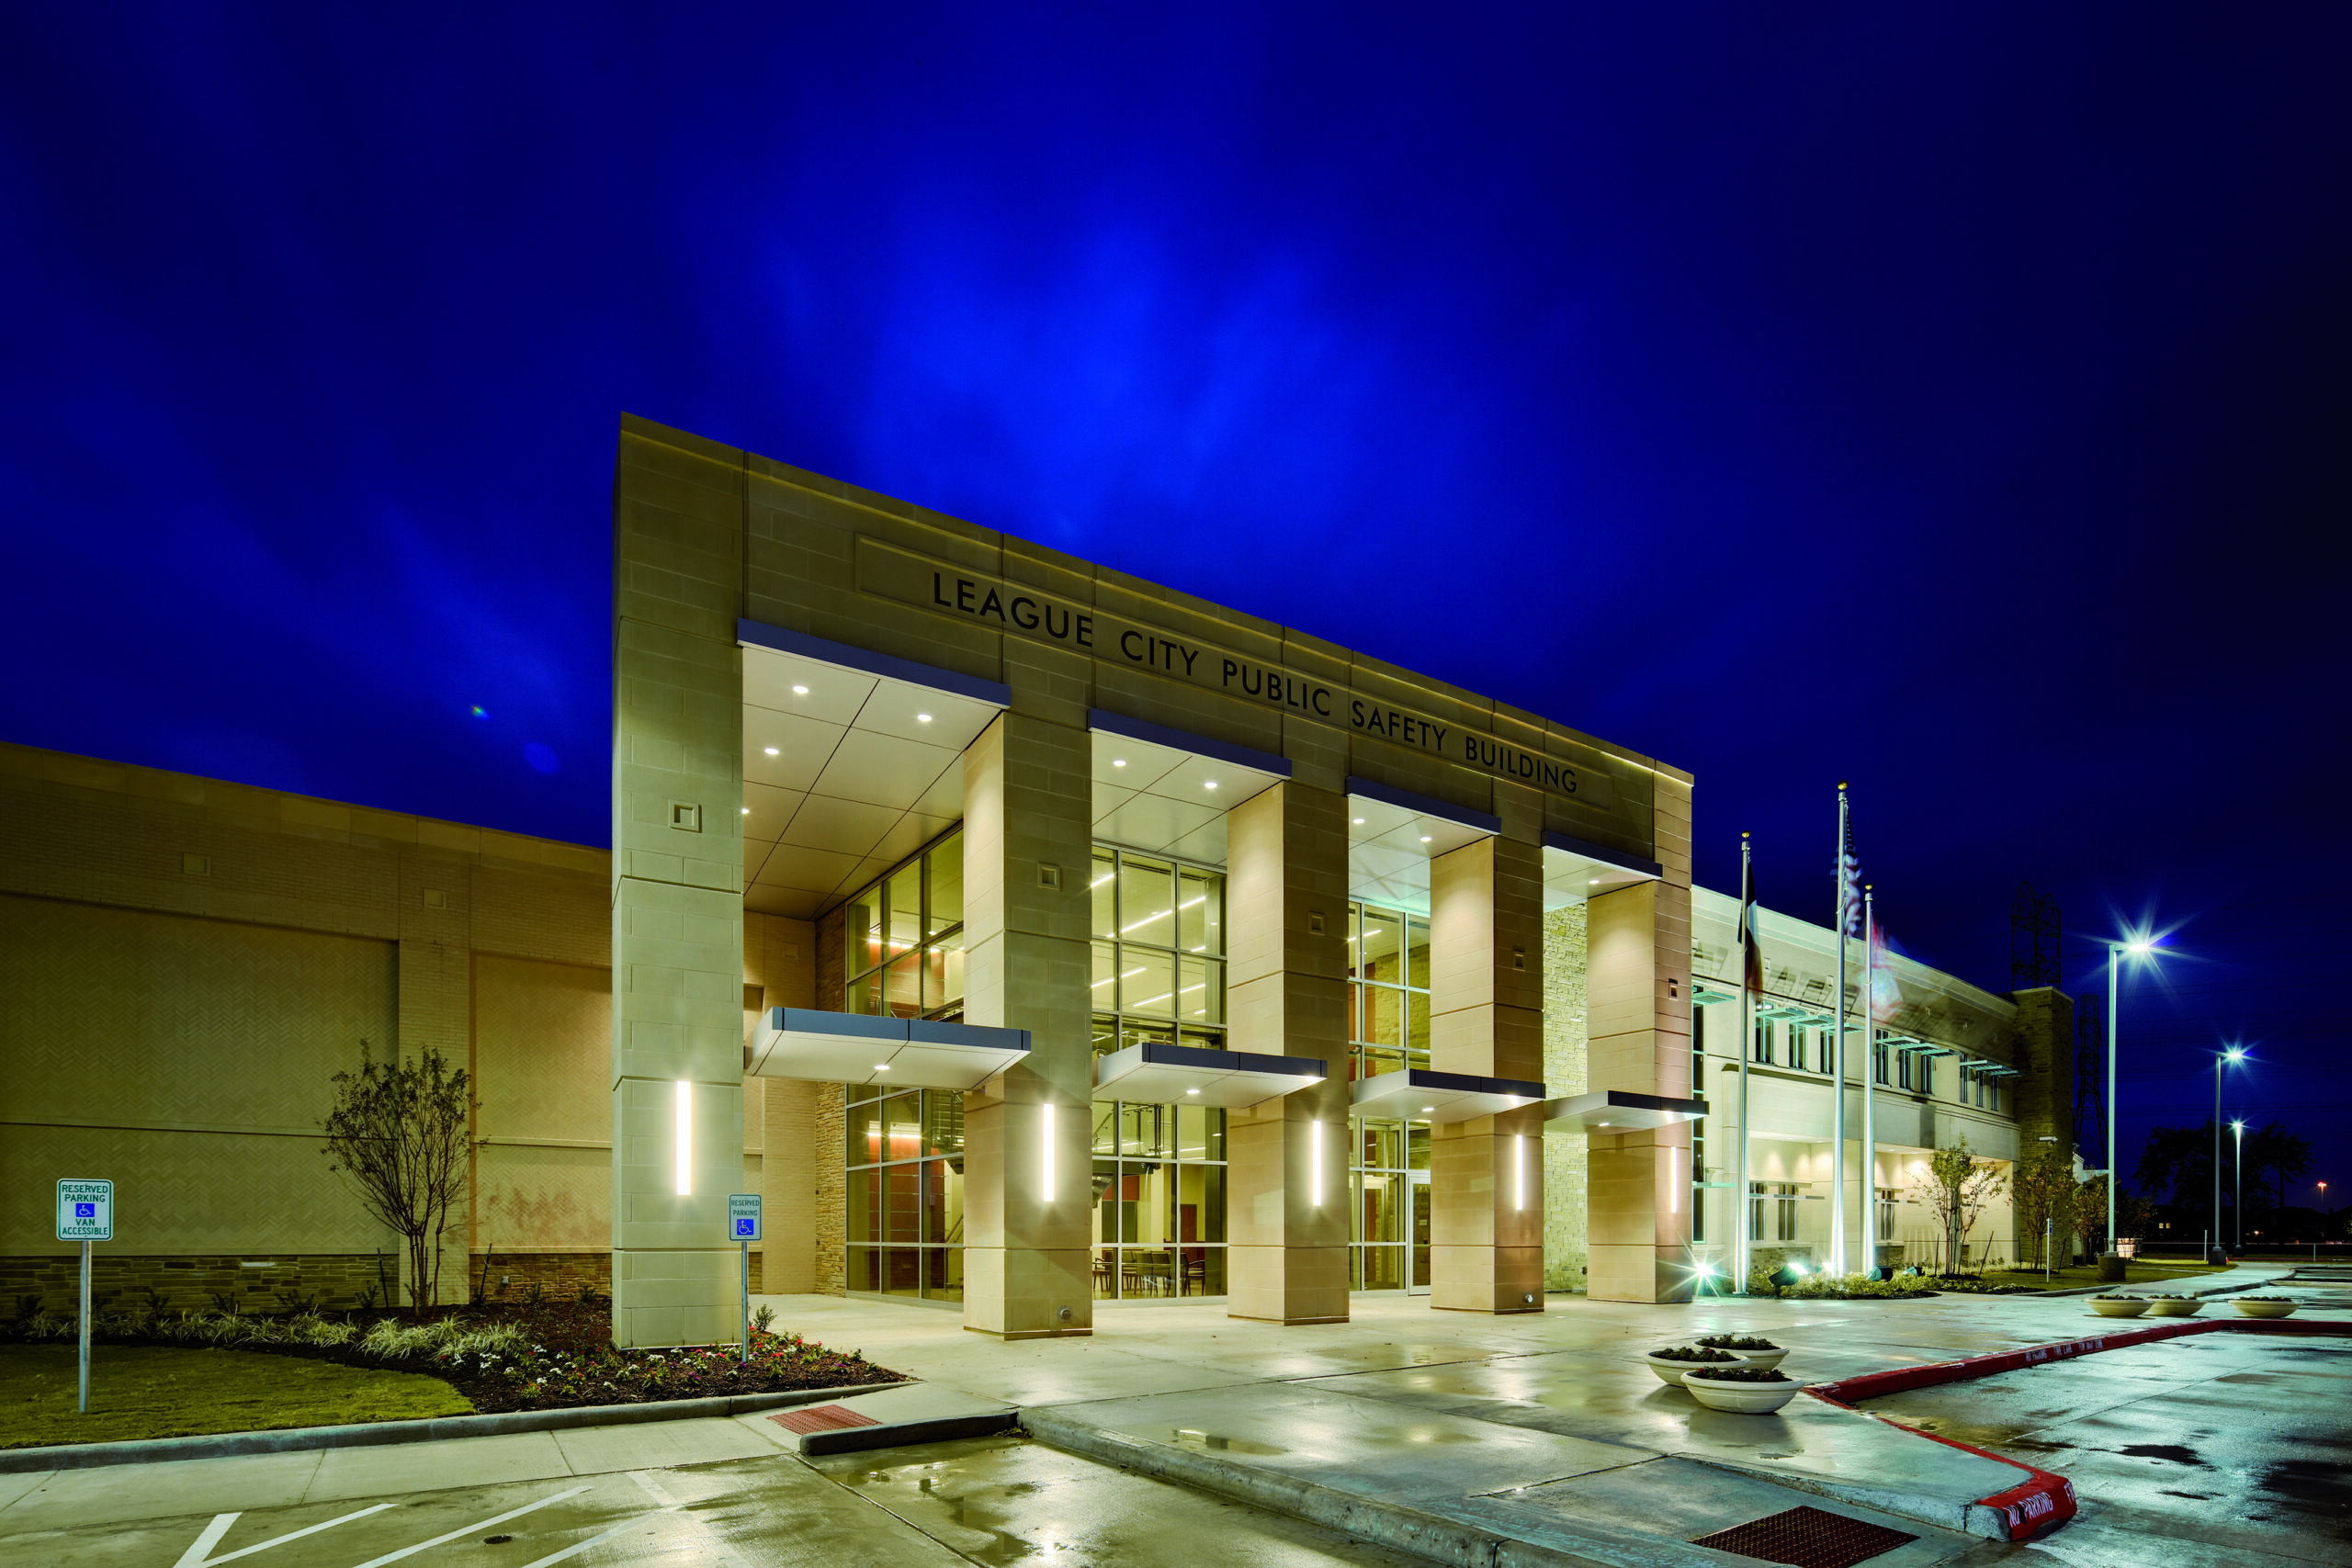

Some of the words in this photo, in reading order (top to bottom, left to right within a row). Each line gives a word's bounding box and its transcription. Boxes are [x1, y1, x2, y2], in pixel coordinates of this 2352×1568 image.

[933, 571, 1093, 648] LEAGUE
[1120, 630, 1199, 677] CITY
[1223, 659, 1331, 717] PUBLIC
[1351, 701, 1447, 752] SAFETY
[1465, 735, 1577, 794] BUILDING
[62, 1185, 108, 1193] RESERVED
[64, 1194, 106, 1202] PARKING
[75, 1218, 95, 1226] VAN
[62, 1227, 108, 1235] ACCESSIBLE
[2002, 1505, 2020, 1529] NO
[2018, 1492, 2053, 1521] PARKING
